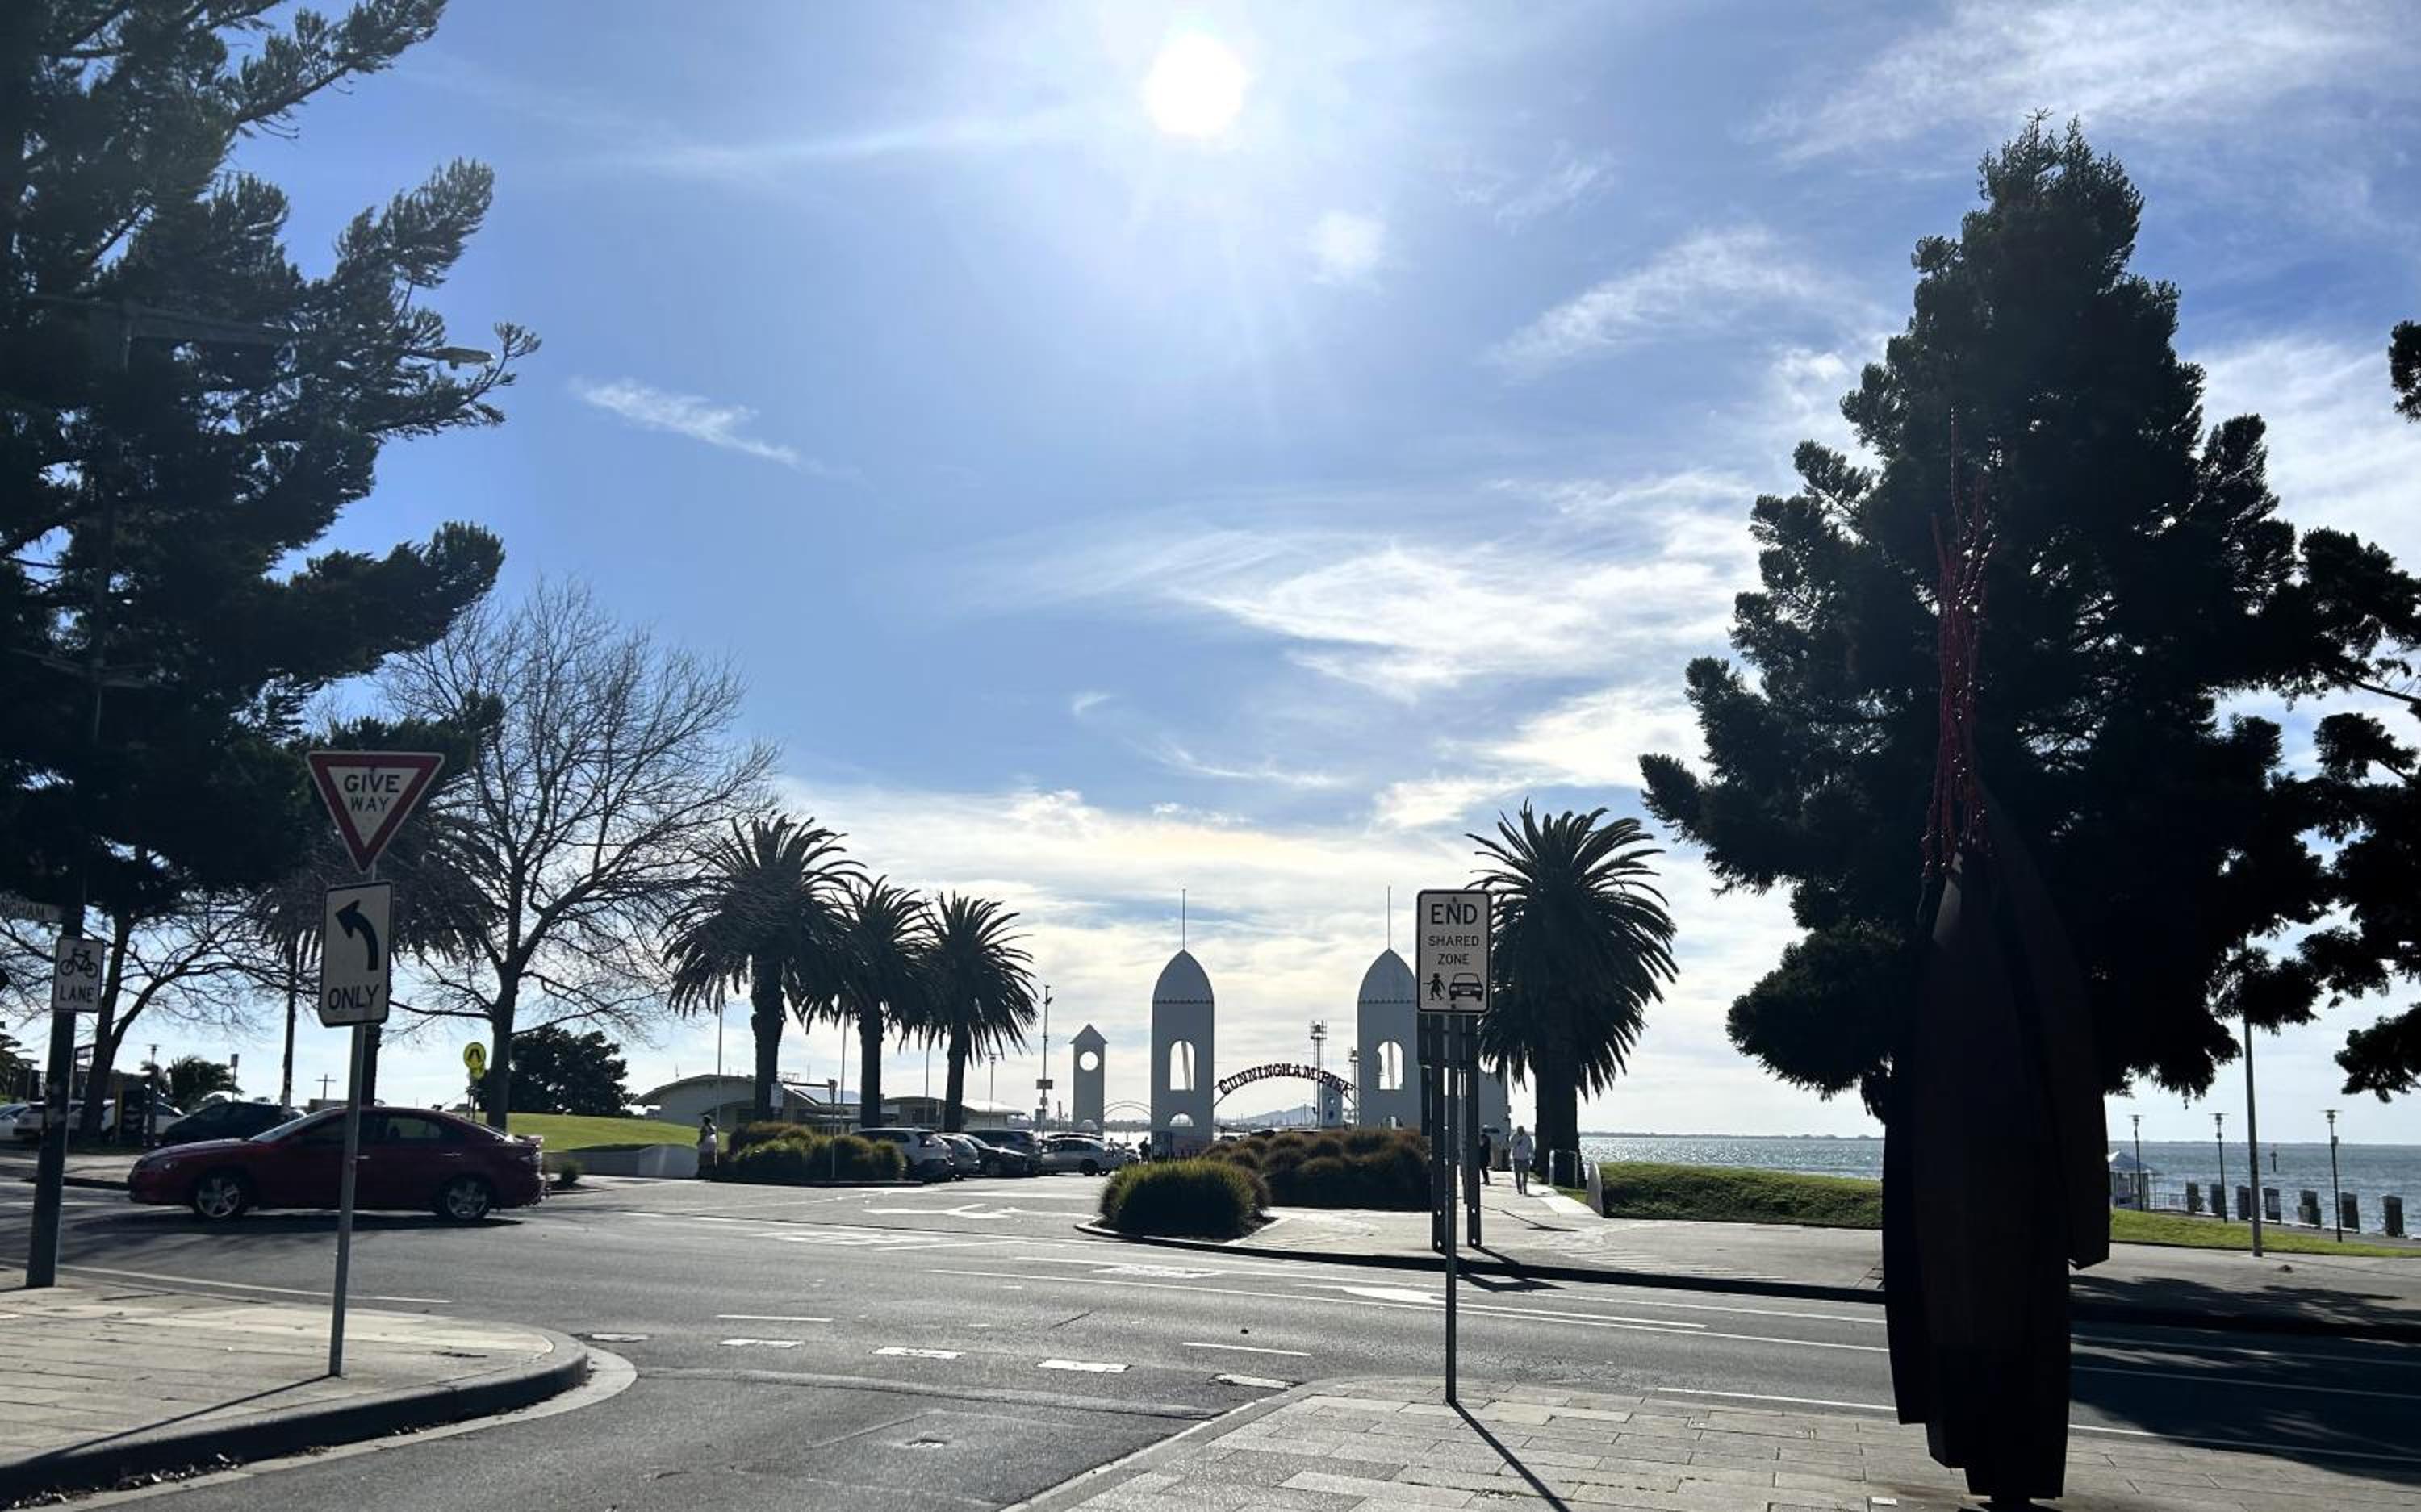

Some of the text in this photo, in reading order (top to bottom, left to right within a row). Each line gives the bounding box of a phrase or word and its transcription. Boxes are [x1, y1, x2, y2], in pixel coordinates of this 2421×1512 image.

[344, 775, 402, 794] GIVE
[351, 796, 390, 812] WAY
[1431, 904, 1478, 925] END
[1428, 934, 1479, 946] SHARED
[1437, 954, 1470, 966] ZONE
[60, 985, 95, 1003] LANE
[328, 984, 380, 1010] ONLY
[1218, 1063, 1318, 1096] CUNNINGHAM
